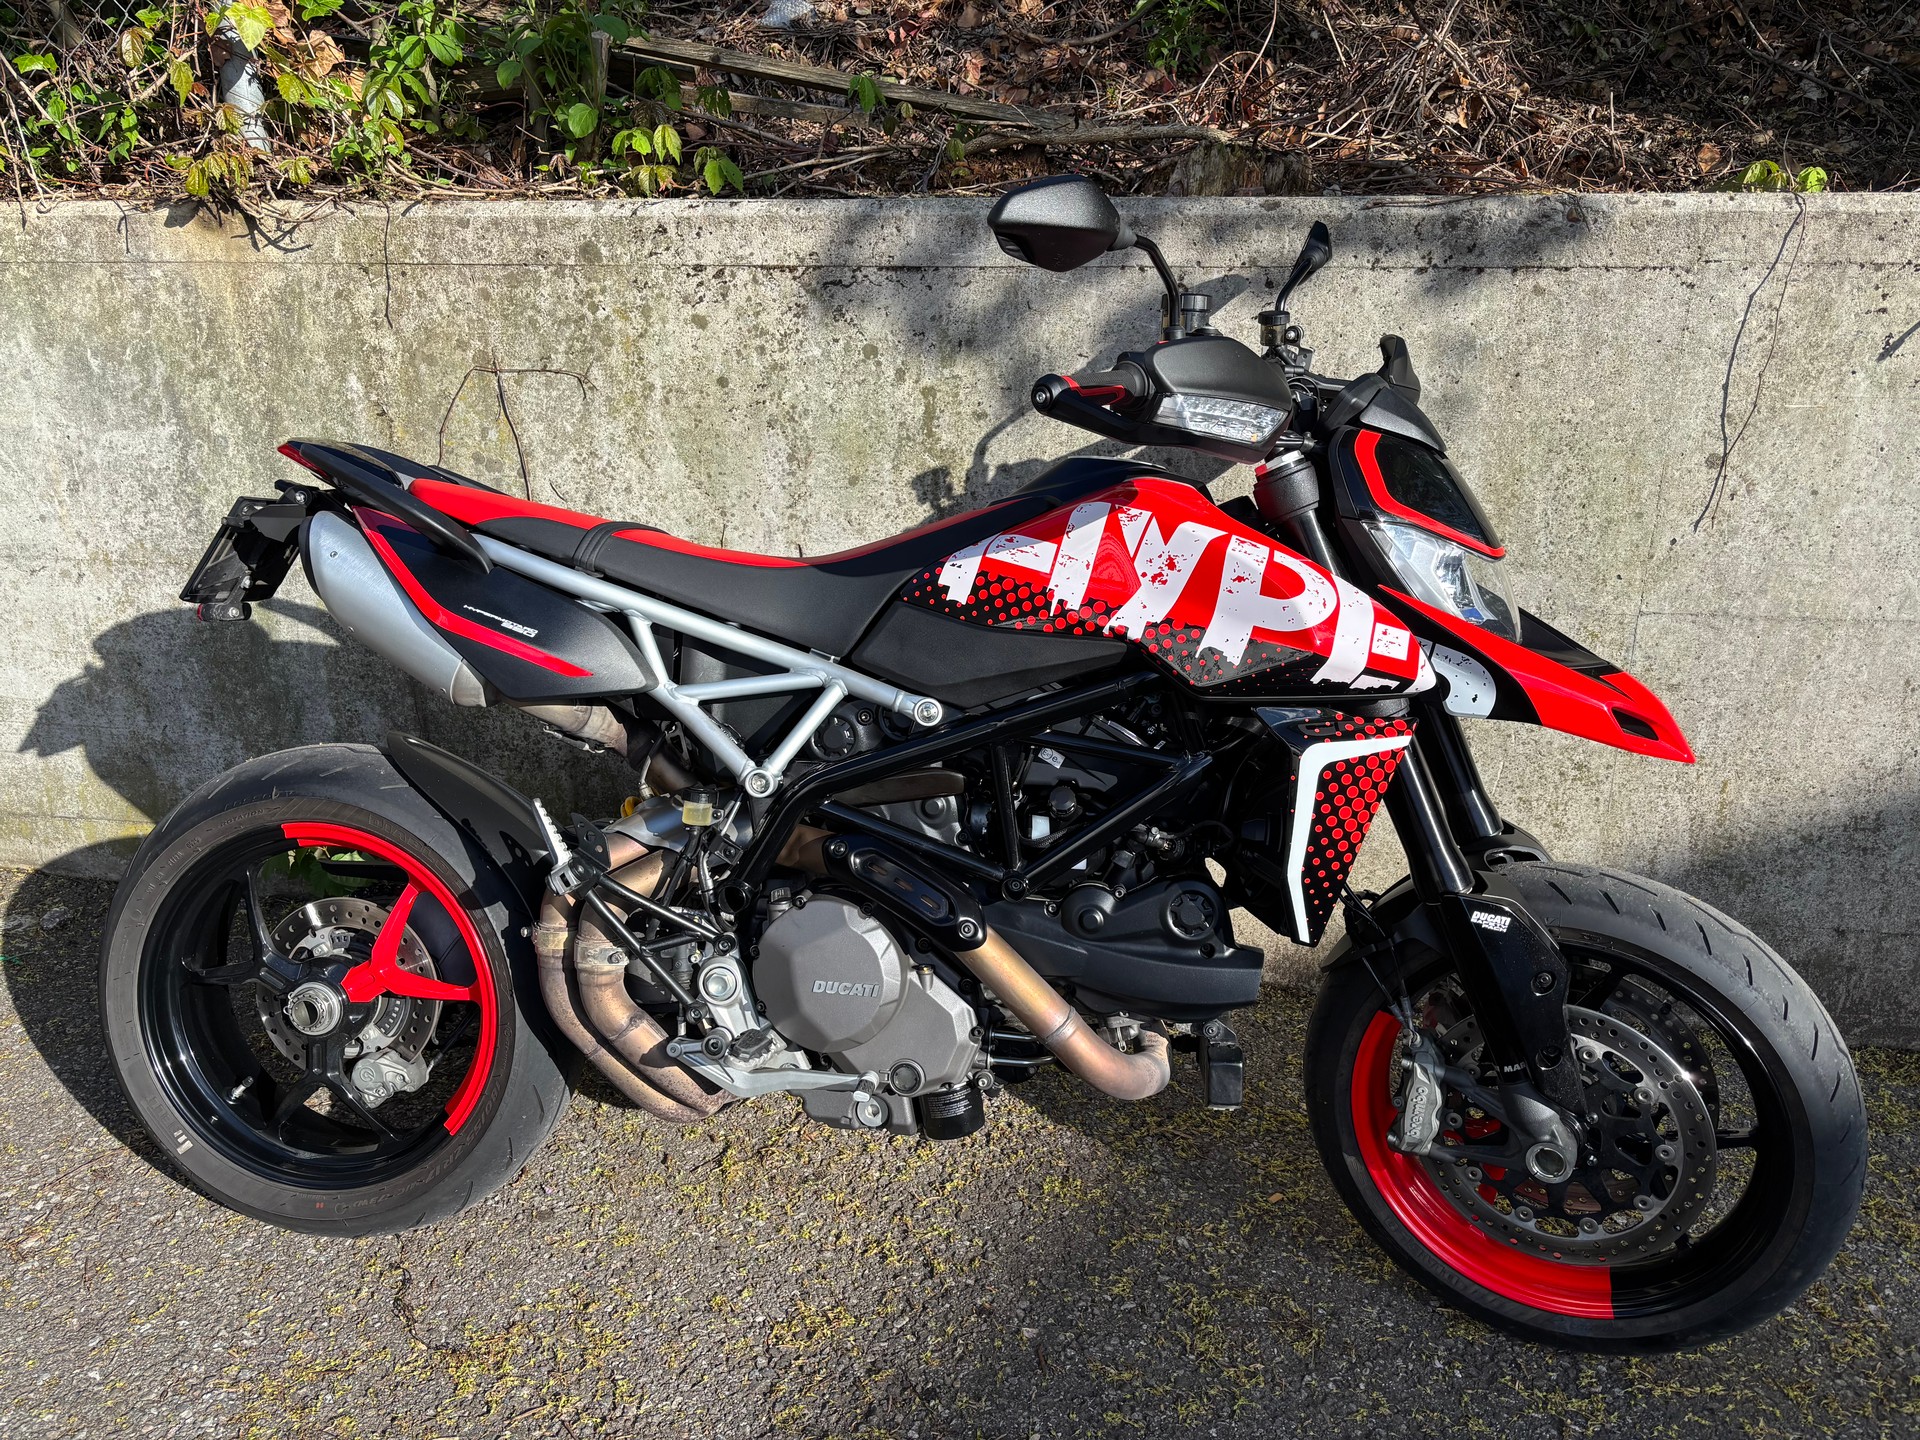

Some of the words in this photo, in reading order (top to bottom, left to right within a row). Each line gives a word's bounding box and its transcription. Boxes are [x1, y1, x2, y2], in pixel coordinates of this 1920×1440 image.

[1471, 910, 1512, 926] DUCATI
[812, 980, 880, 998] DUCATI
[1405, 1086, 1428, 1139] brembo
